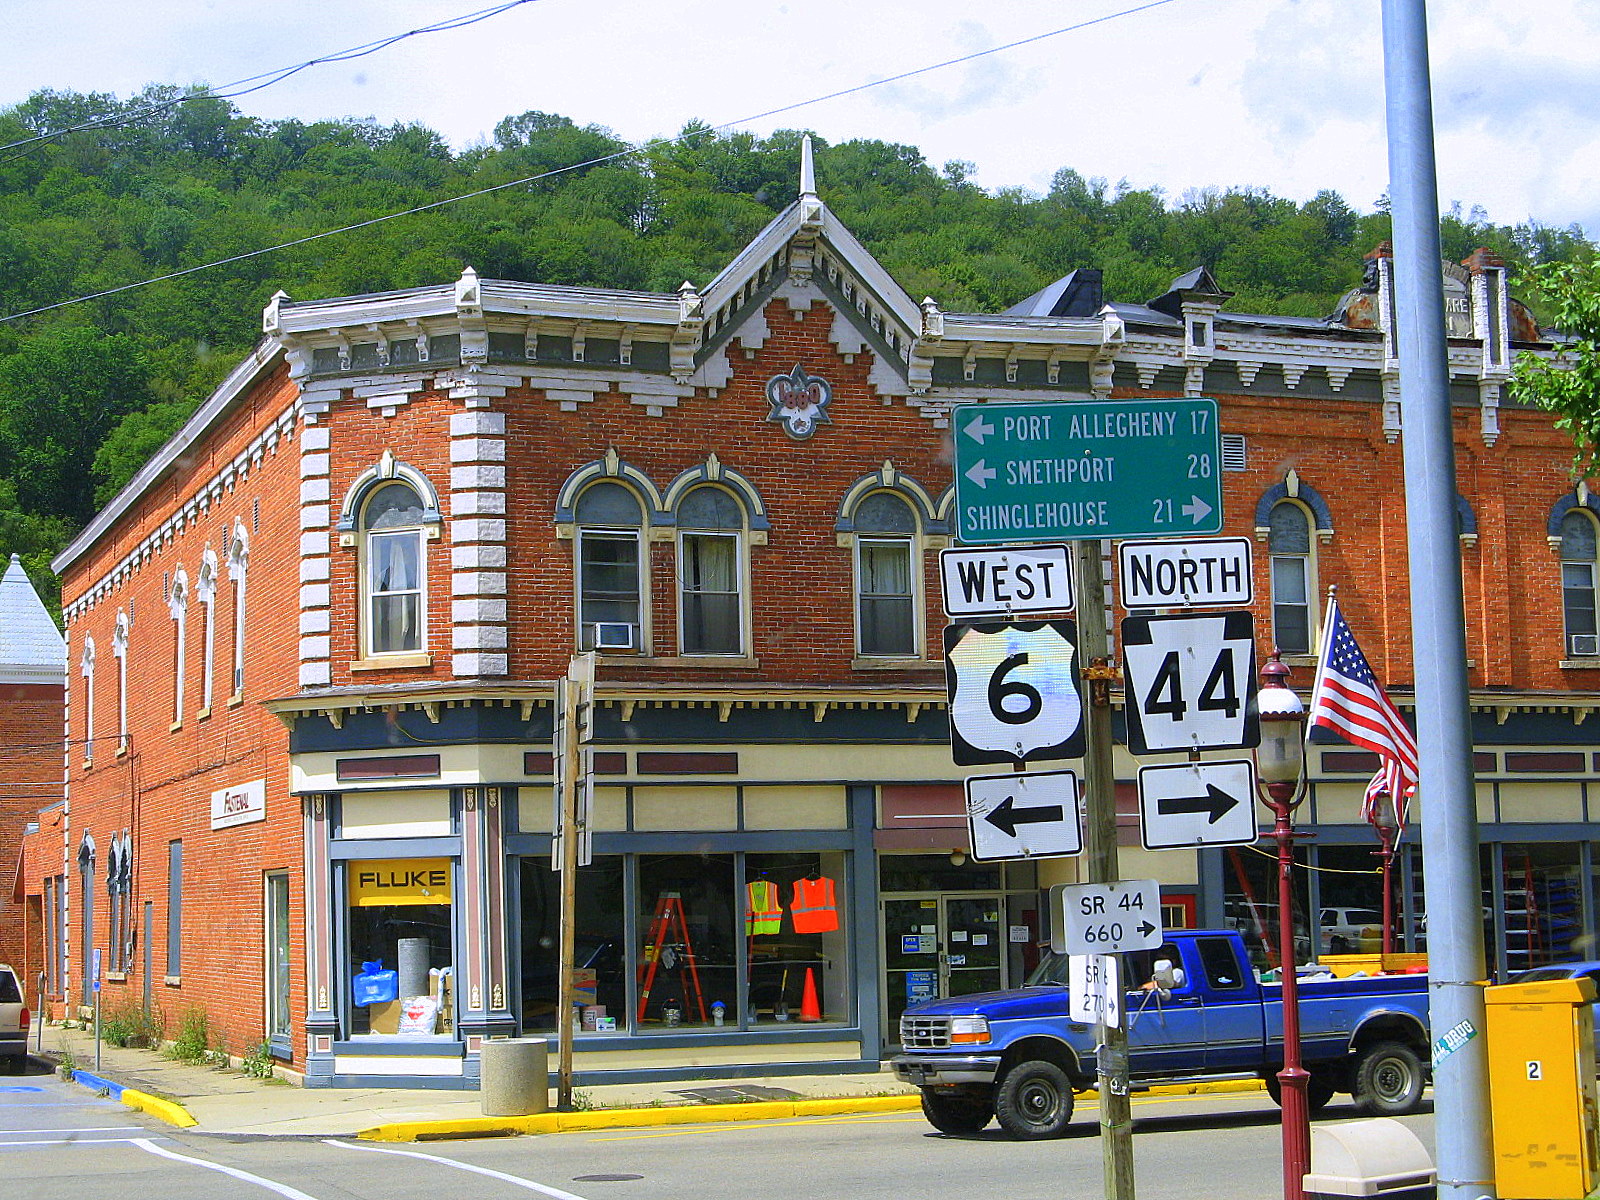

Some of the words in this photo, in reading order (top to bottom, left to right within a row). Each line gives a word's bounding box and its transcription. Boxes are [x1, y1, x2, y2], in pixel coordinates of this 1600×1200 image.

[1004, 415, 1051, 441] PORT
[1069, 411, 1177, 439] ALLEGHENY
[1190, 410, 1209, 435] 17
[1006, 457, 1115, 485] SMETHPORT
[1187, 454, 1211, 479] 28
[967, 501, 1109, 531] SHINGLEHOUSE
[1152, 498, 1173, 523] 21
[957, 560, 1054, 603] WEST
[1130, 554, 1241, 597] NORTH
[988, 652, 1042, 725] 6
[1144, 648, 1240, 722] 44
[359, 870, 446, 888] FLUKE
[1080, 895, 1105, 916] SR
[1118, 892, 1144, 912] 44
[1084, 923, 1123, 943] 660
[1085, 965, 1099, 984] SR
[1083, 993, 1104, 1012] 270
[1442, 1020, 1474, 1048] DRUG
[1528, 1062, 1539, 1079] 2
